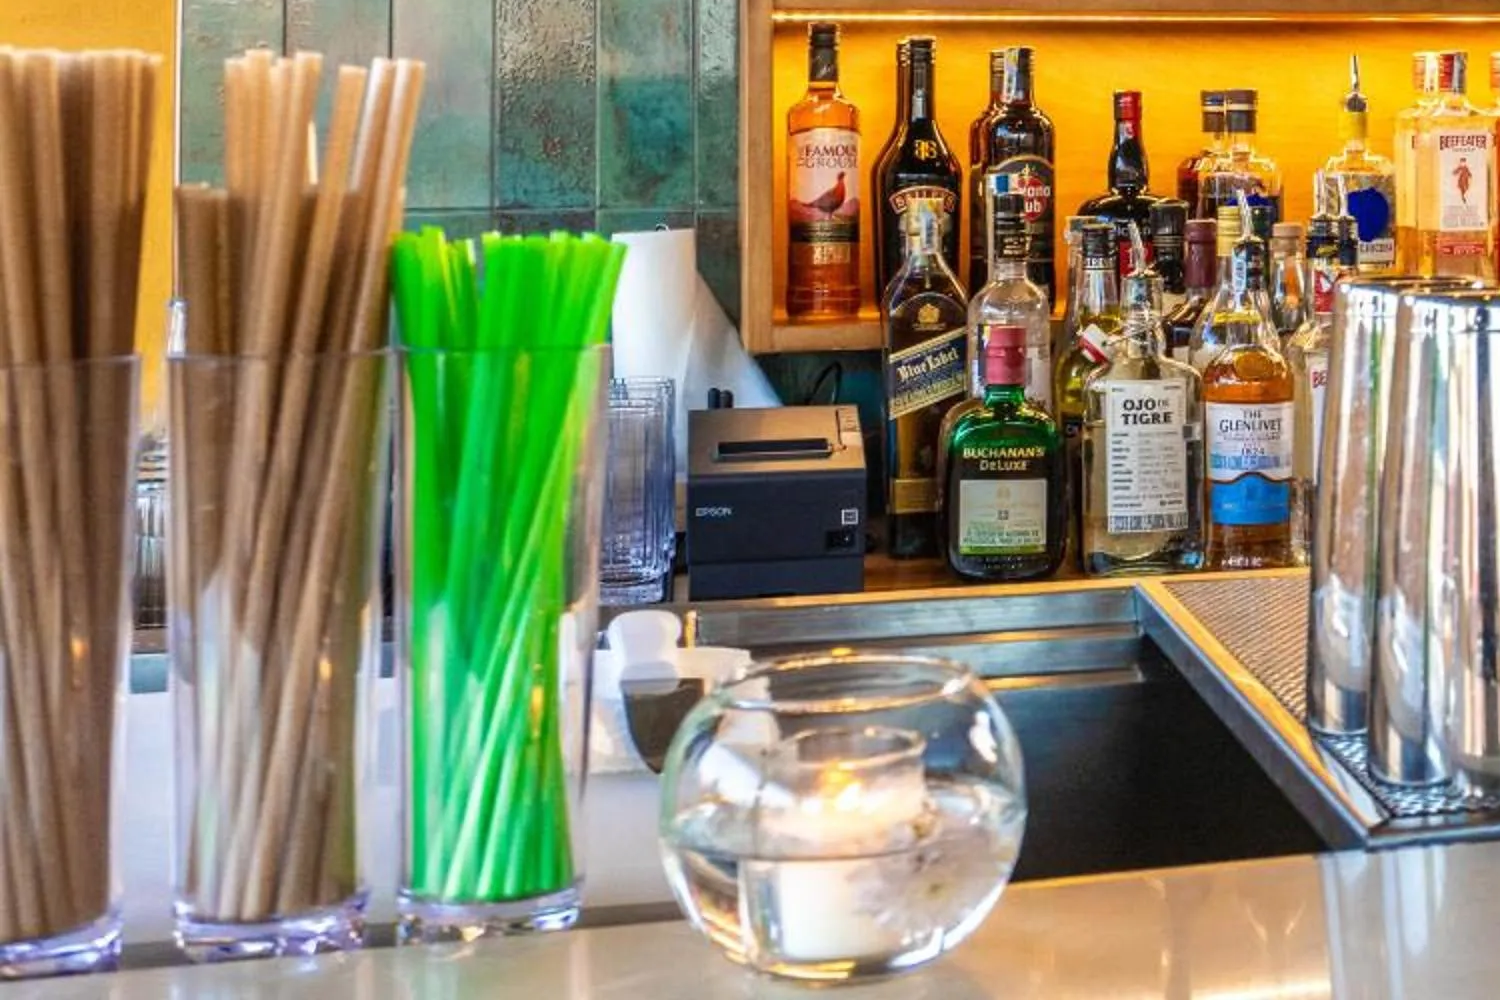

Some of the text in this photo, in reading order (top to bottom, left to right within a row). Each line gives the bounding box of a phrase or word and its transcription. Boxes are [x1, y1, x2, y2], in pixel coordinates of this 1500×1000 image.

[1439, 135, 1486, 150] BEEFEATER
[925, 347, 959, 371] Label
[1123, 397, 1156, 411] OJO
[1121, 412, 1173, 425] TIGRE
[1243, 410, 1261, 418] THE
[1219, 418, 1281, 432] GLENLIVET
[963, 447, 1045, 458] BUCHANAN'S
[695, 507, 733, 517] EPSON
